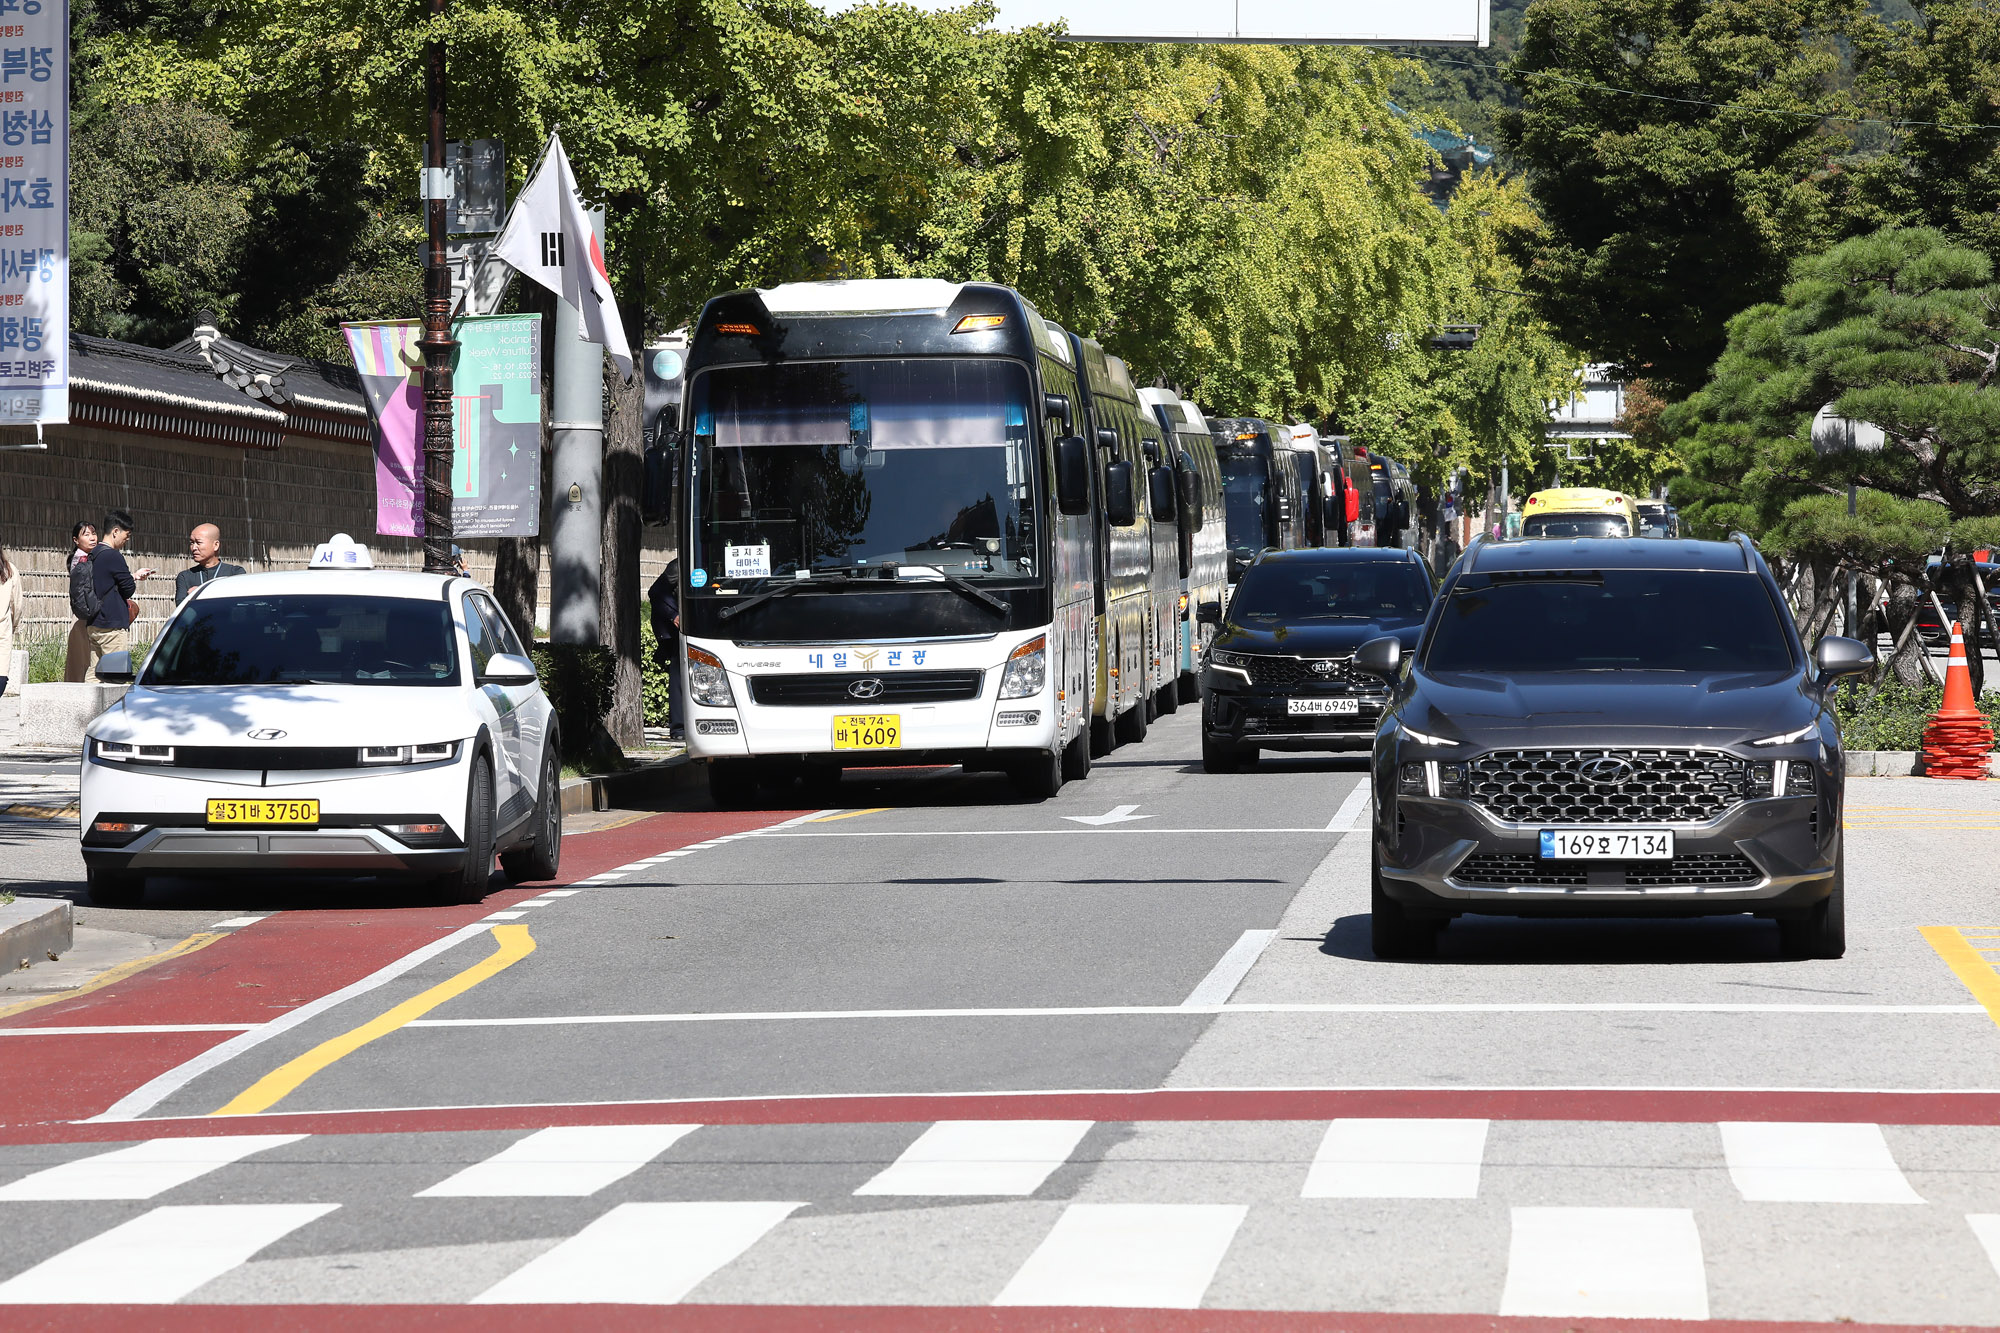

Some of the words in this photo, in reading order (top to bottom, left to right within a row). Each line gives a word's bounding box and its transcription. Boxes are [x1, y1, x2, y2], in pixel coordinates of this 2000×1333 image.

[320, 551, 357, 563] 서울
[736, 558, 760, 567] 테마식
[809, 653, 847, 669] 내일
[887, 650, 927, 666] 관광
[736, 661, 782, 669] UNIVERSE
